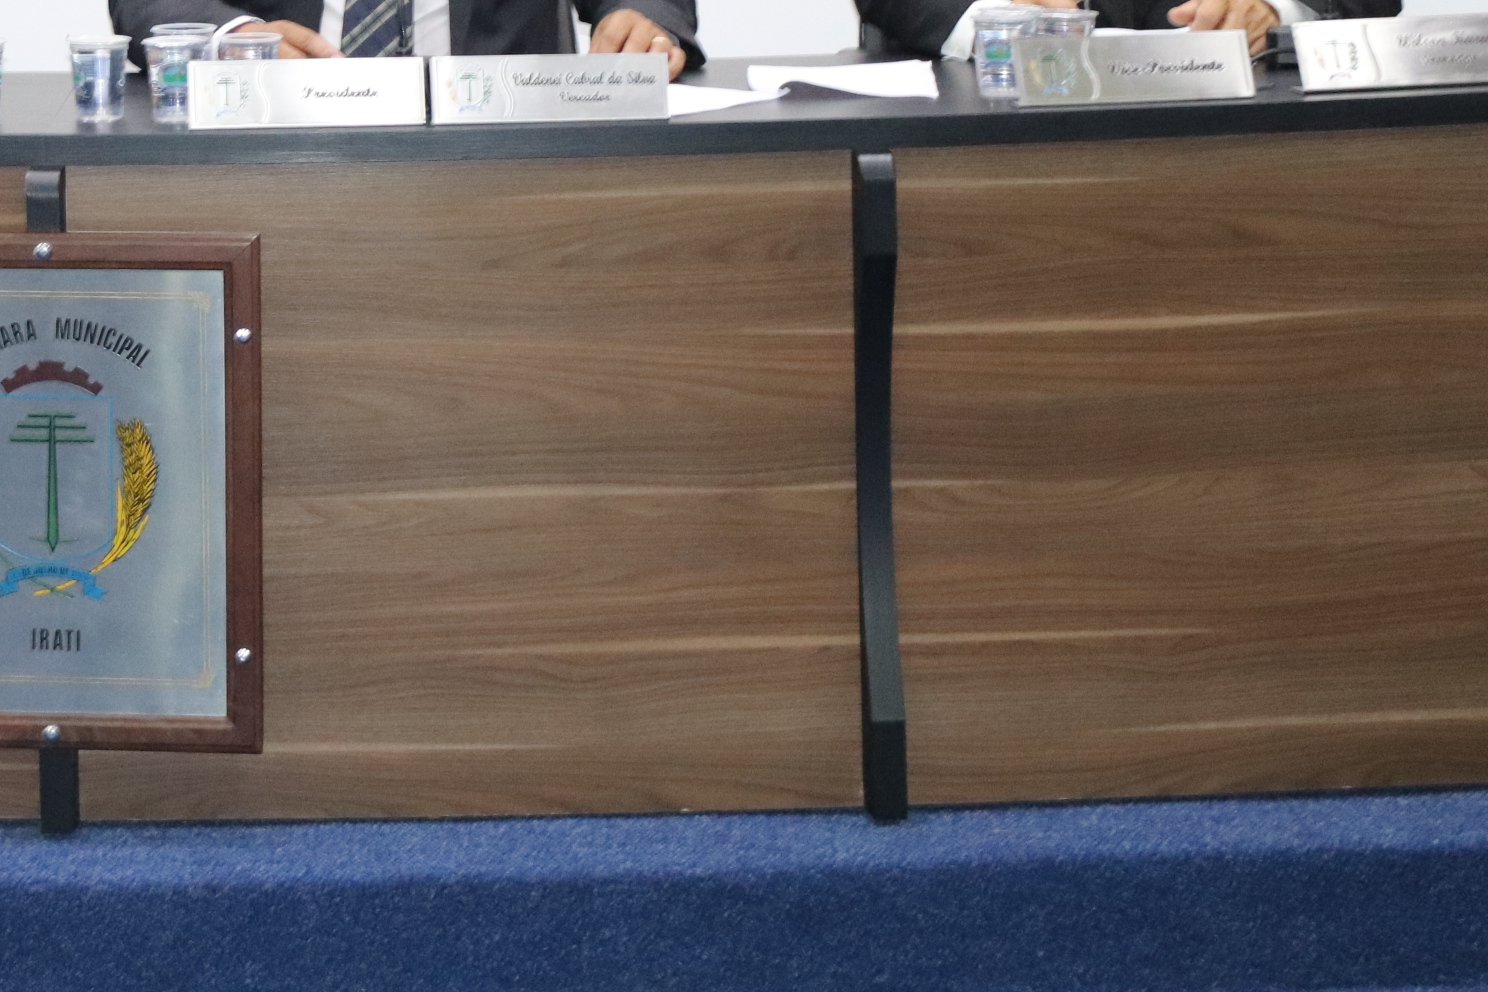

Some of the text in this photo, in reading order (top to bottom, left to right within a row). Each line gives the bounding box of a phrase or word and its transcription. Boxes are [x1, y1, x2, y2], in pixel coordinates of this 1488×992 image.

[565, 71, 604, 85] Cabral
[608, 71, 623, 84] da
[627, 71, 657, 84] Silva
[559, 91, 611, 102] Vereador
[55, 317, 151, 370] MUNICIPAL
[31, 628, 82, 652] IRATI
